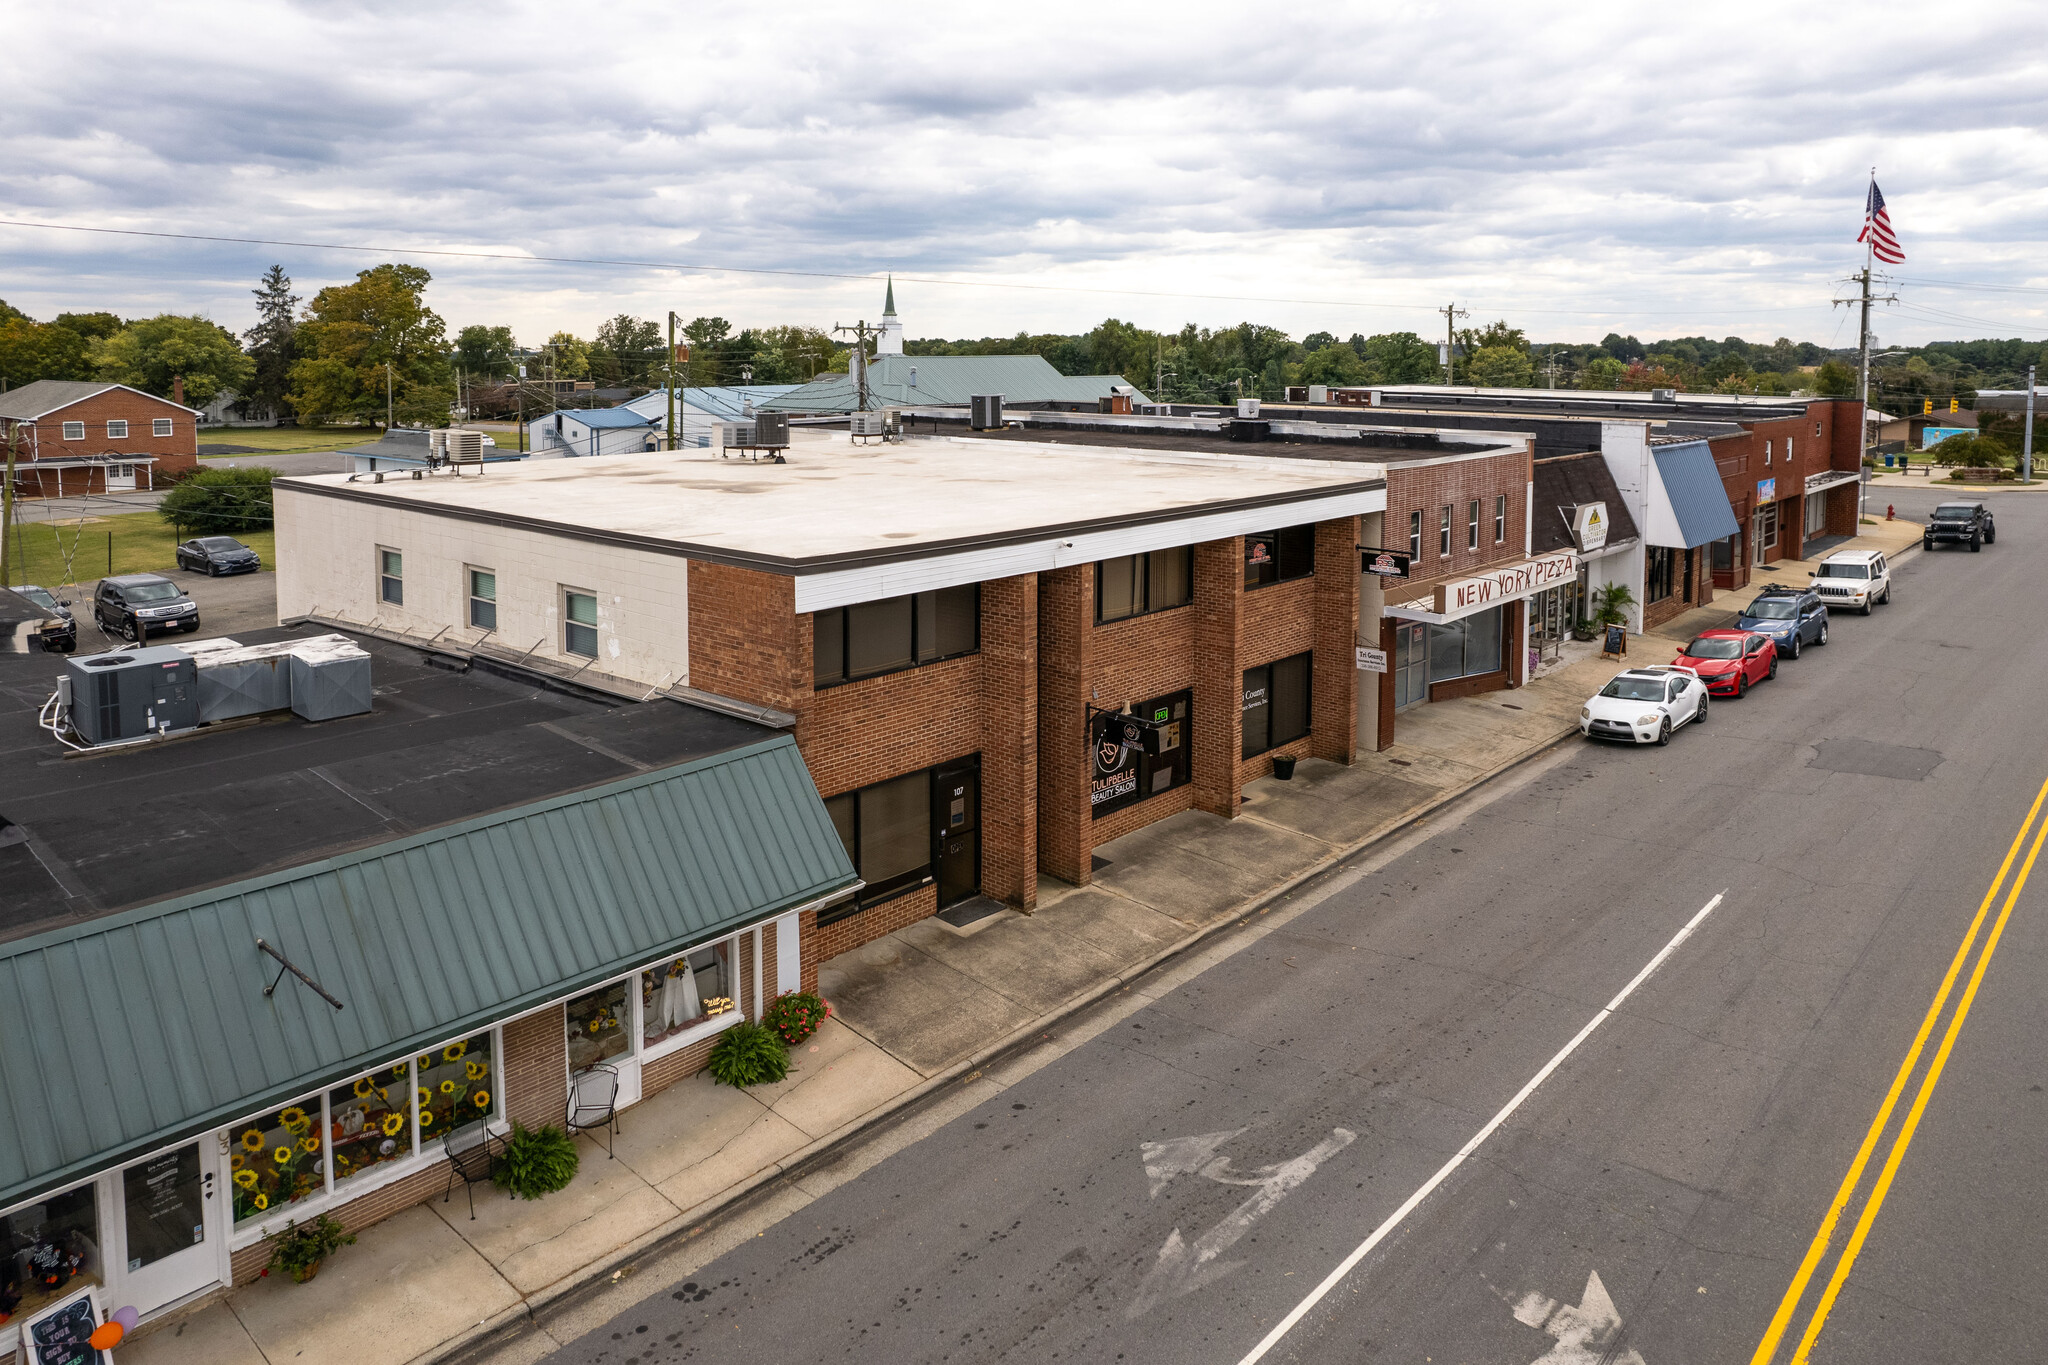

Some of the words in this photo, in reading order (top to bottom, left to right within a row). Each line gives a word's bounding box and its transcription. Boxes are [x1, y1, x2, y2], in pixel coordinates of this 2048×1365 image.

[1457, 581, 1492, 608] NEW
[1499, 565, 1532, 597] YORK
[1535, 555, 1572, 585] PIZZA
[1368, 652, 1383, 661] County
[1246, 688, 1265, 700] County
[1156, 710, 1168, 720] OPEN
[1092, 768, 1135, 792] TULIPBELLE
[953, 786, 964, 796] 107
[1092, 788, 1114, 803] BEAUTY
[1115, 781, 1135, 795] SALON
[41, 1321, 56, 1335] THIS
[62, 1315, 69, 1325] IS
[49, 1327, 70, 1342] YOUR
[45, 1345, 62, 1360] SIGN
[68, 1336, 77, 1346] TO
[57, 1351, 71, 1365] BUY
